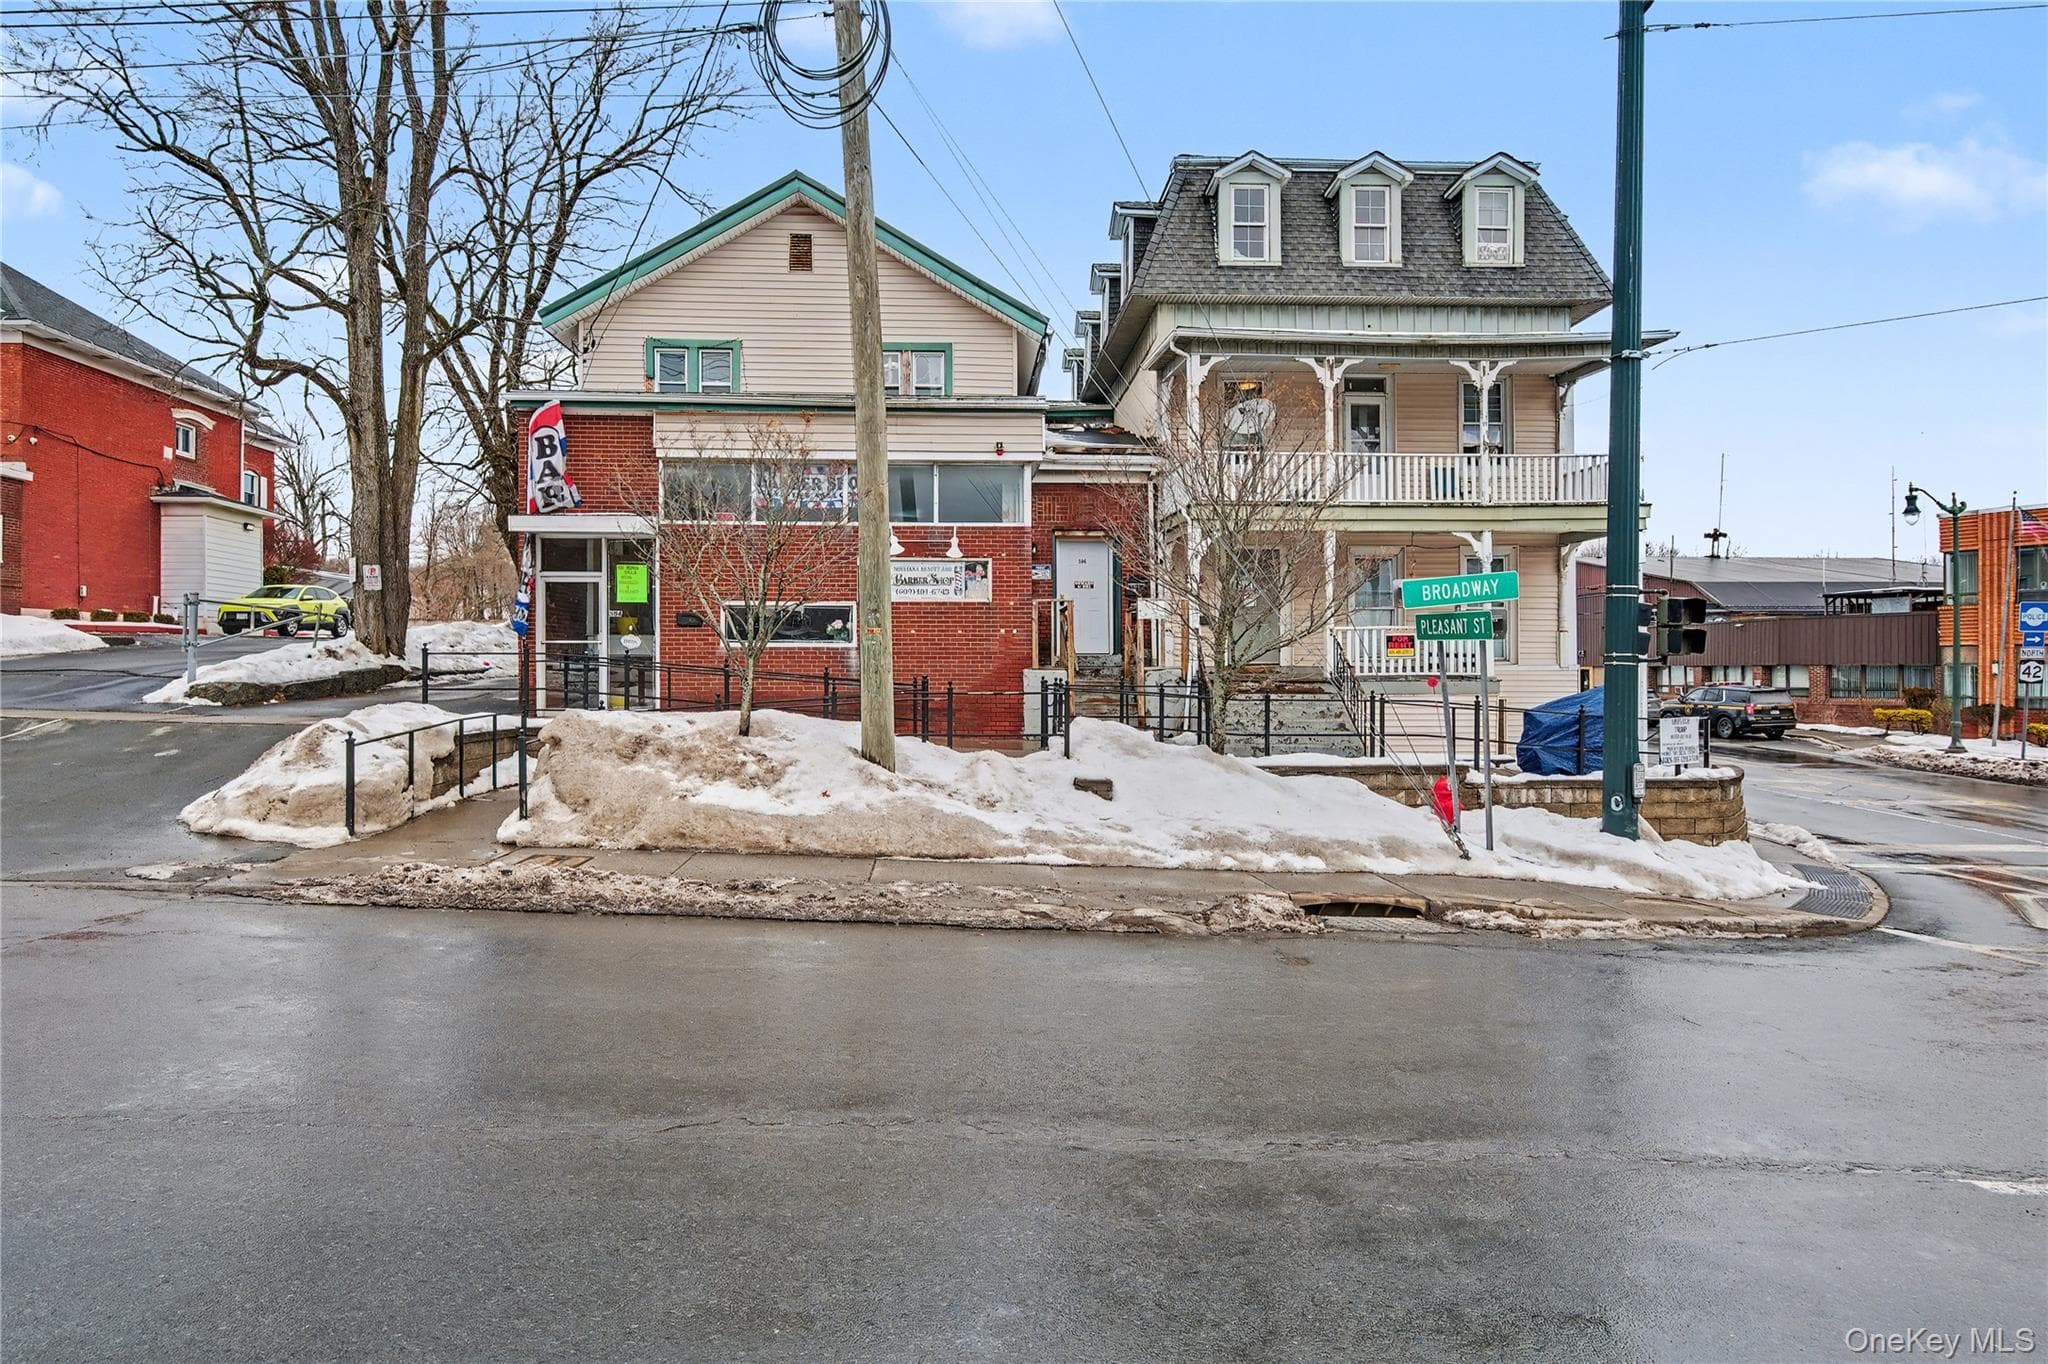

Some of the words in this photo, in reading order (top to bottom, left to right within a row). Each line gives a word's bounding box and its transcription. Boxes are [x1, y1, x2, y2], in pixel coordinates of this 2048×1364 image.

[893, 573, 929, 586] BARBER
[929, 573, 955, 586] SHOP
[1422, 579, 1499, 601] BROADWAY
[2022, 613, 2046, 621] POLICE
[1420, 617, 1468, 635] PLEASANT
[1473, 617, 1487, 634] ST
[2022, 665, 2042, 678] 42
